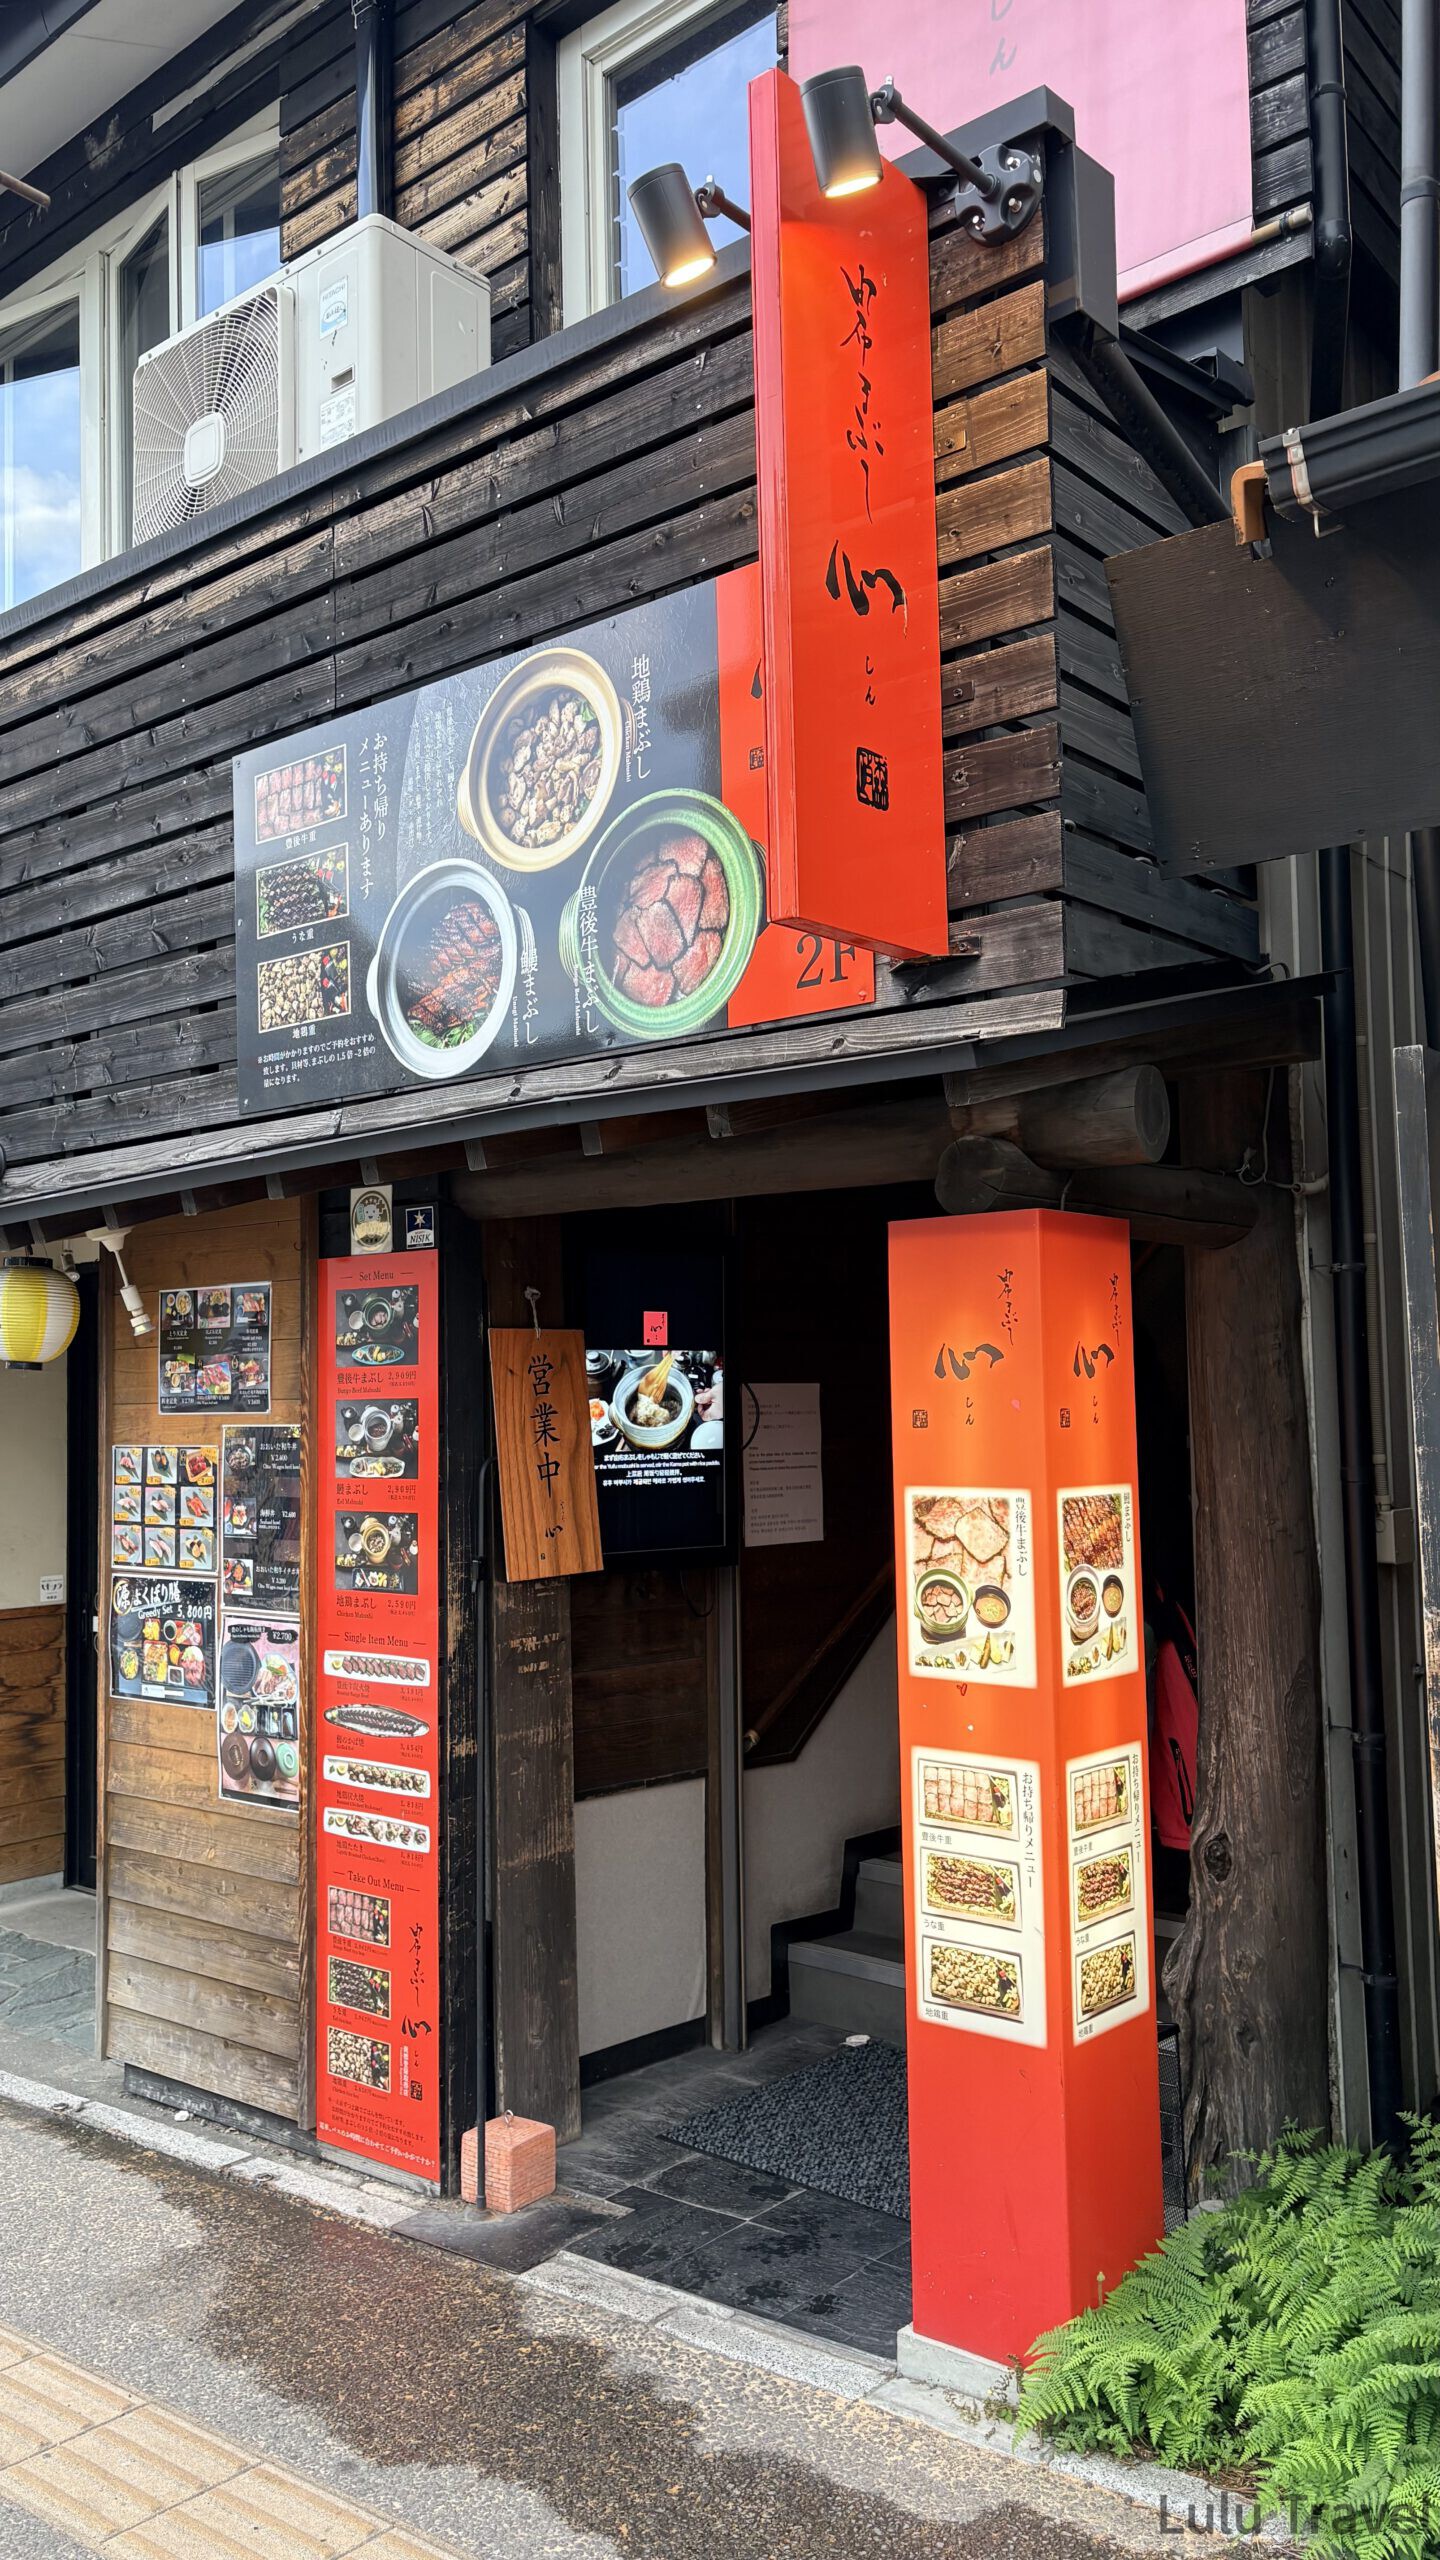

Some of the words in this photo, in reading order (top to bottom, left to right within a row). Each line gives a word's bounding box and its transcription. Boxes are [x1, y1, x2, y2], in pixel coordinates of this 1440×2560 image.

[631, 654, 652, 780] 地鶏まぶし
[358, 737, 373, 900] メニューあります
[373, 732, 389, 842] お持ち帰り
[520, 948, 539, 1045] 鰻まぶし
[579, 886, 600, 1034] 豊後牛まぶし
[796, 933, 856, 990] 2F
[359, 1271, 371, 1282] Set
[373, 1270, 395, 1281] Menu
[337, 1372, 384, 1384] 豊後牛まぶし
[528, 1353, 562, 1499] 営業中
[138, 1609, 161, 1620] Greedy
[162, 1605, 173, 1615] Set
[344, 1631, 367, 1645] Single
[369, 1633, 385, 1645] Item
[387, 1635, 408, 1647] Menu
[1022, 1773, 1036, 1888] お持ち帰りメニュー
[347, 1870, 366, 1884] Take
[367, 1875, 382, 1887] Out
[383, 1878, 405, 1892] Menu
[923, 1919, 945, 1932] うな重
